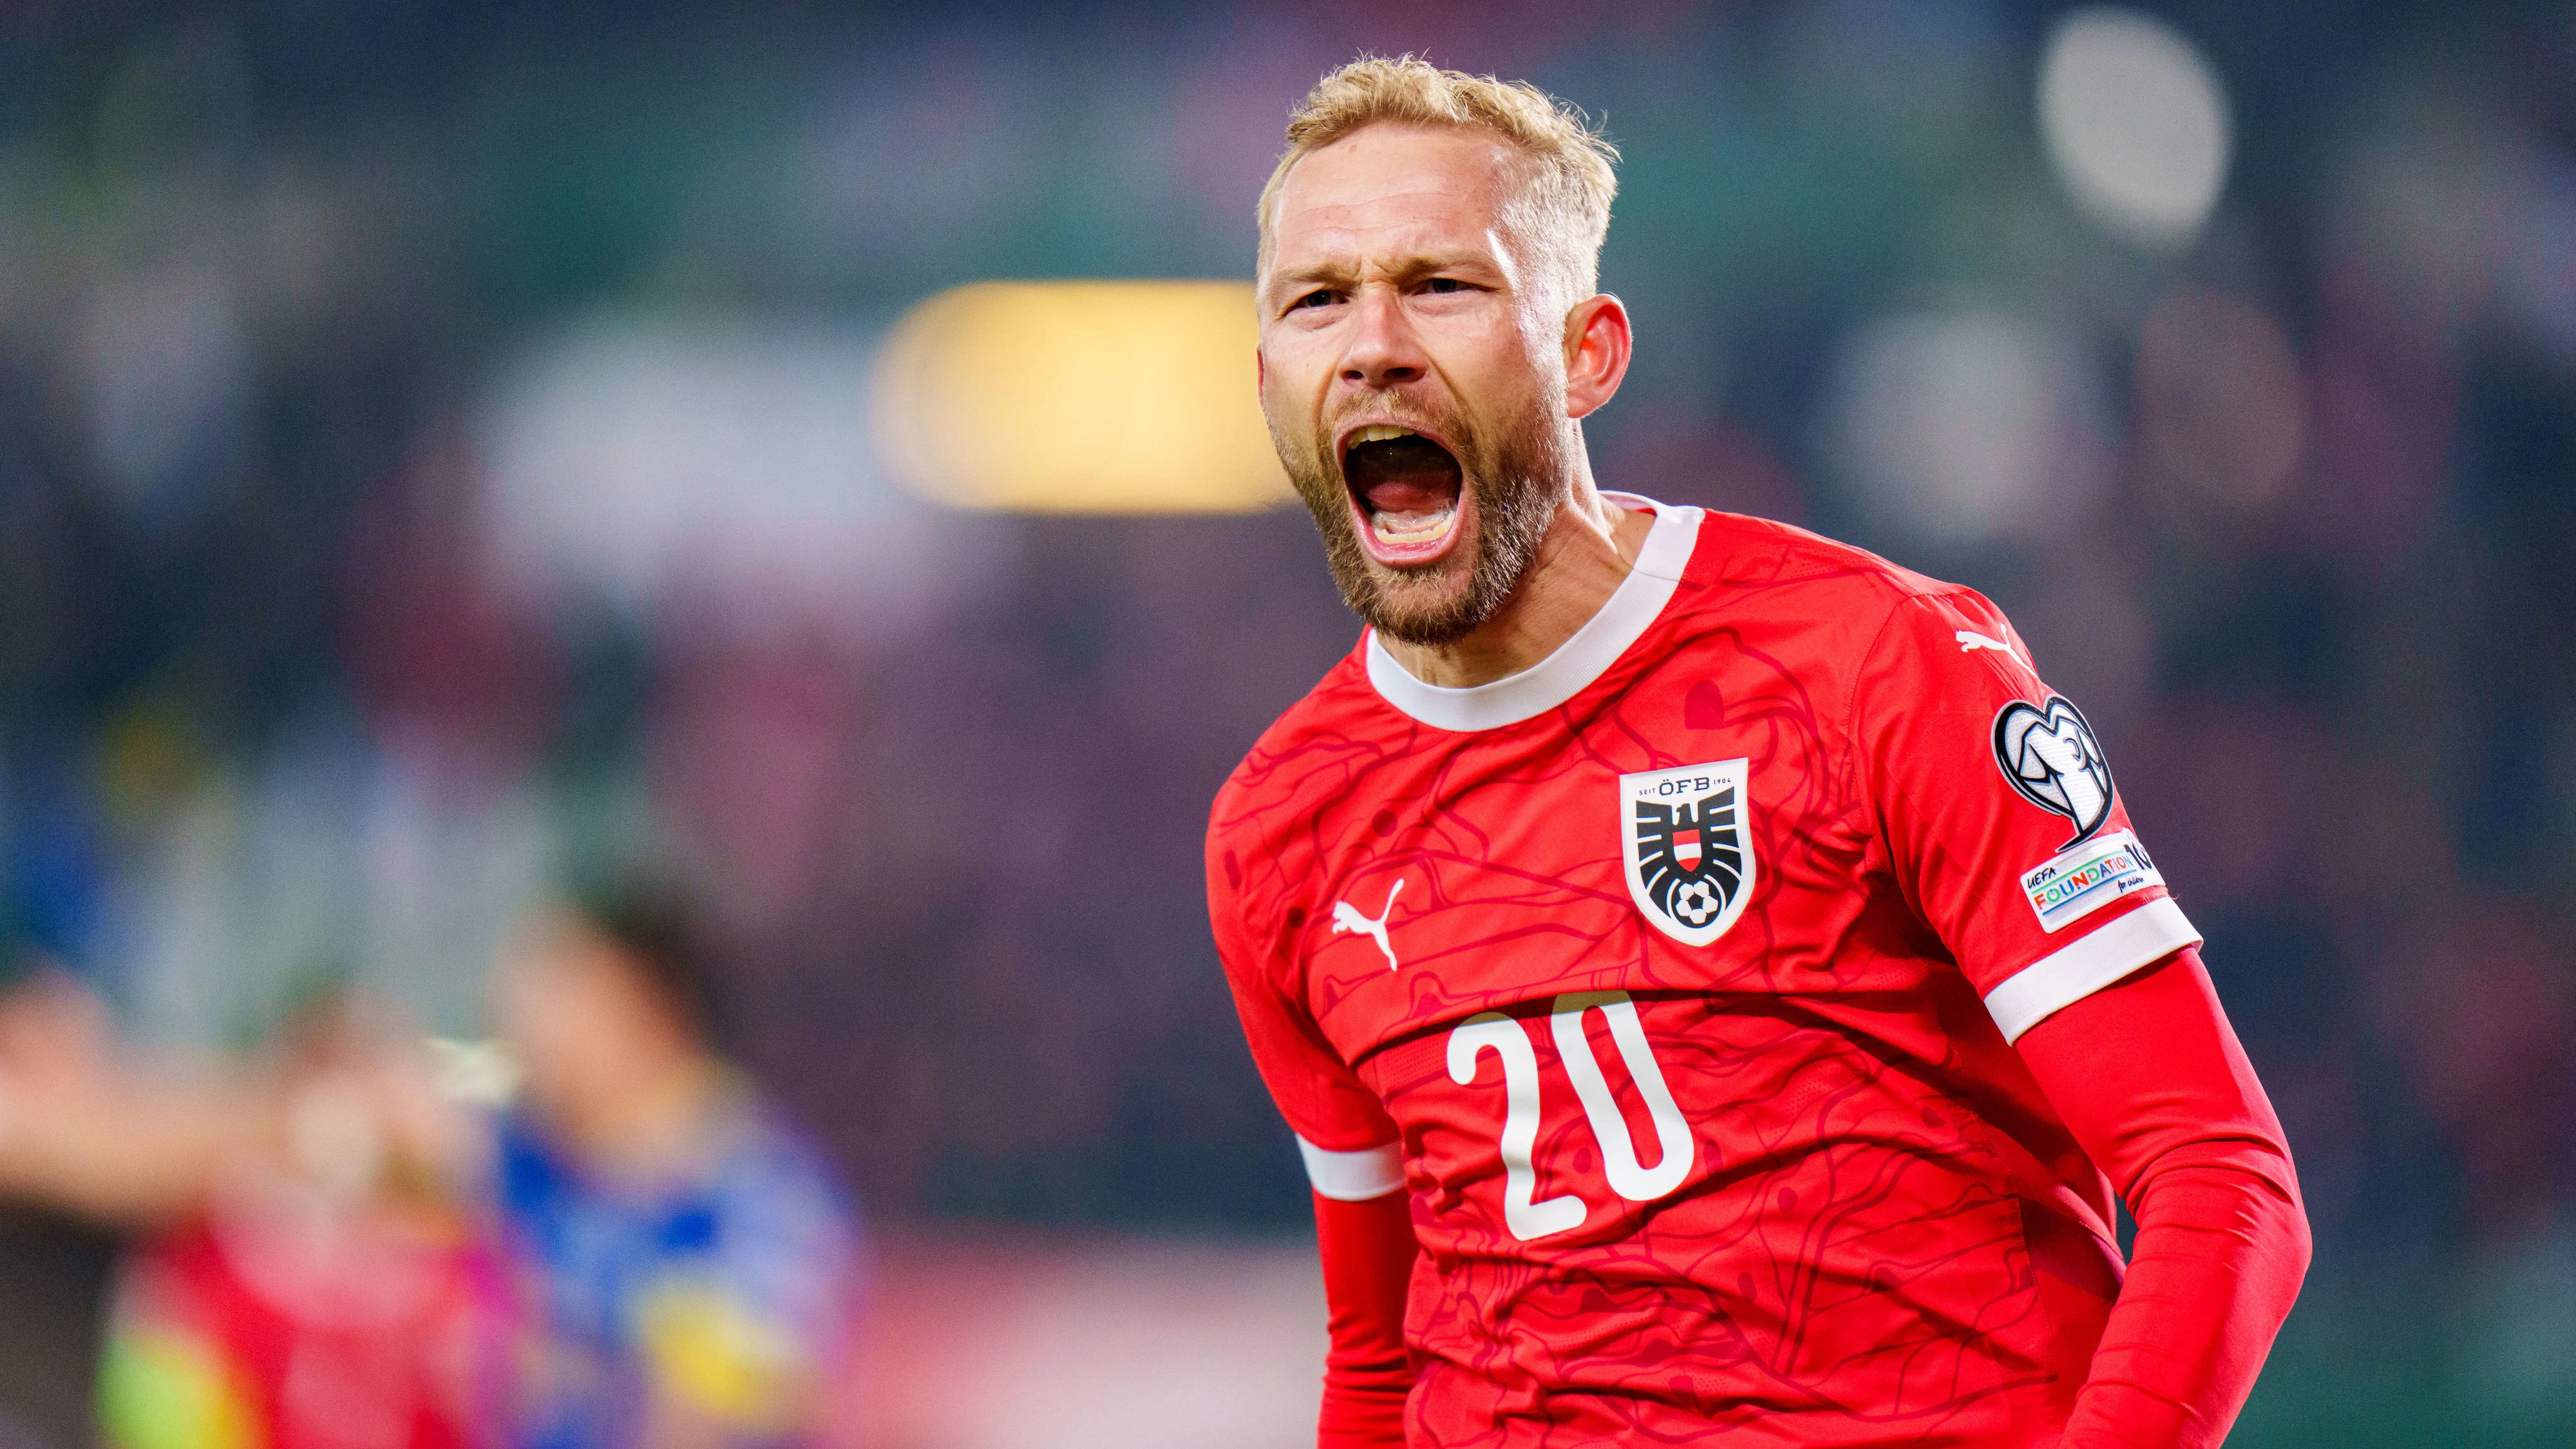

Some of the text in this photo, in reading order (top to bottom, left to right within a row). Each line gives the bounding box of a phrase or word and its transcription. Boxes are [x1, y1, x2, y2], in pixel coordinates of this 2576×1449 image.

[1659, 777, 1710, 796] ÖFB
[2027, 866, 2056, 889] UEFA
[2034, 855, 2134, 910] FOUNDATION
[1446, 989, 1694, 1241] 20
